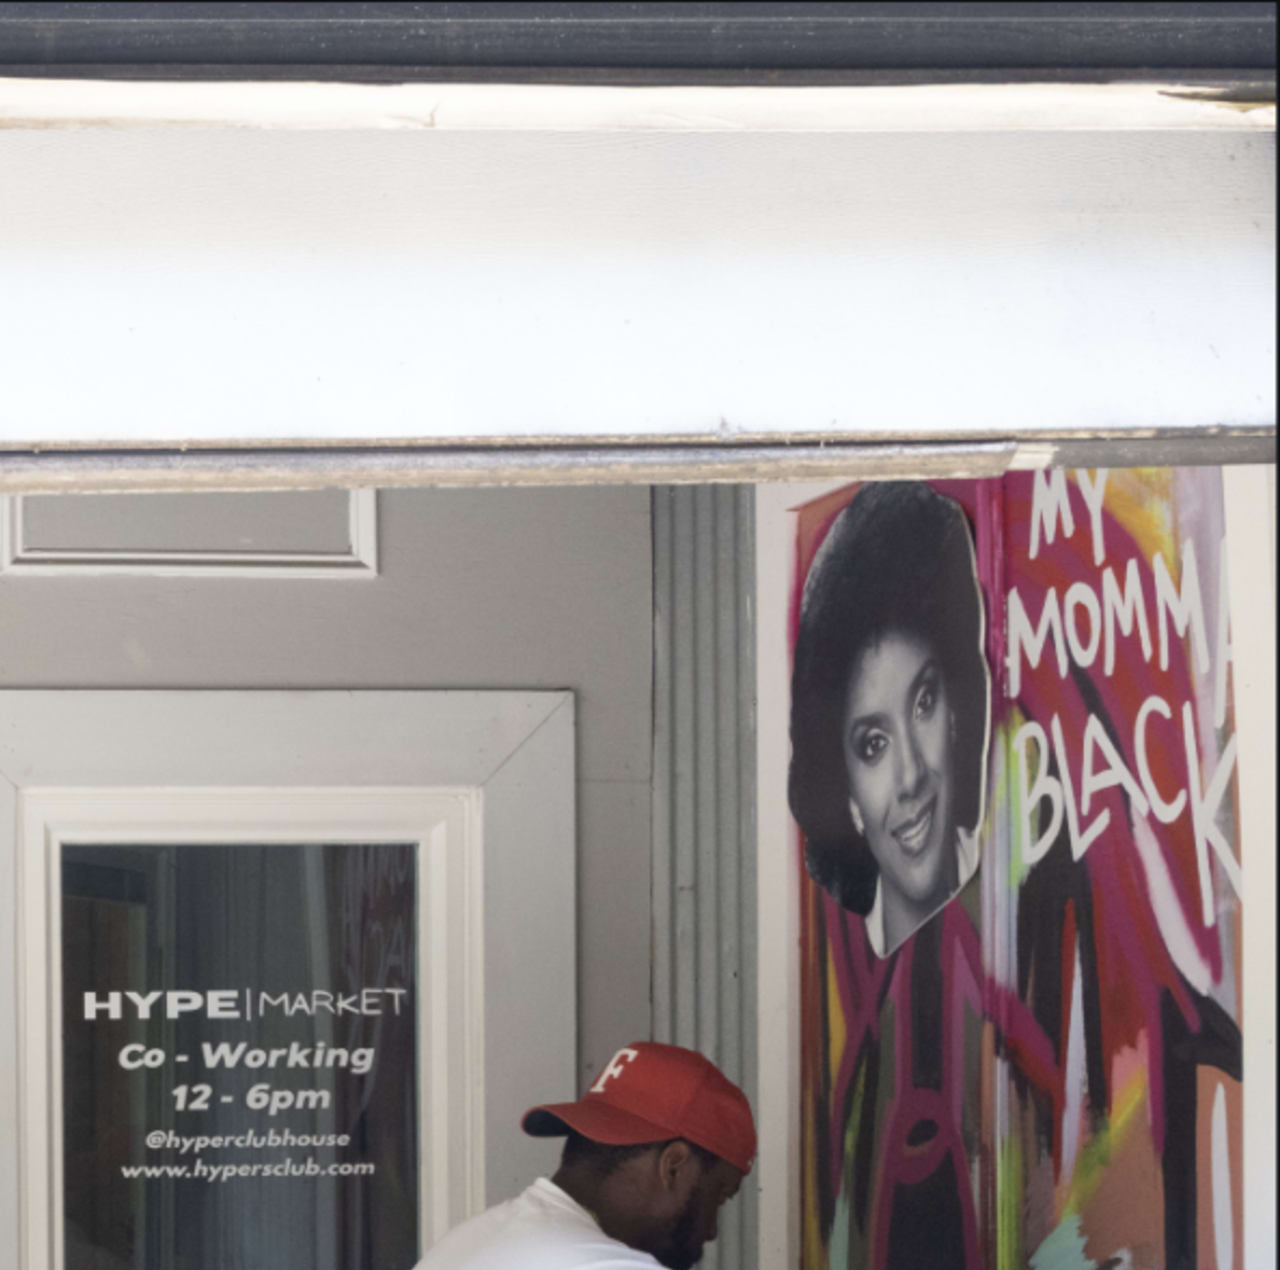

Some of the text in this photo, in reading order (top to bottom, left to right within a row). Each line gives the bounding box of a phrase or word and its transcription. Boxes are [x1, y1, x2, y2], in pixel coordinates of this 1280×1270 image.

[1029, 468, 1109, 566] MY
[1011, 695, 1243, 928] BLACK
[84, 988, 406, 1019] HYPE MARKET
[202, 1042, 375, 1074] Working
[590, 1048, 638, 1093] F
[171, 1084, 213, 1111] 12
[246, 1083, 331, 1115] 6pm
[145, 1129, 351, 1153] @hyperclubhouse
[121, 1158, 375, 1182] www.hypersclub.com
